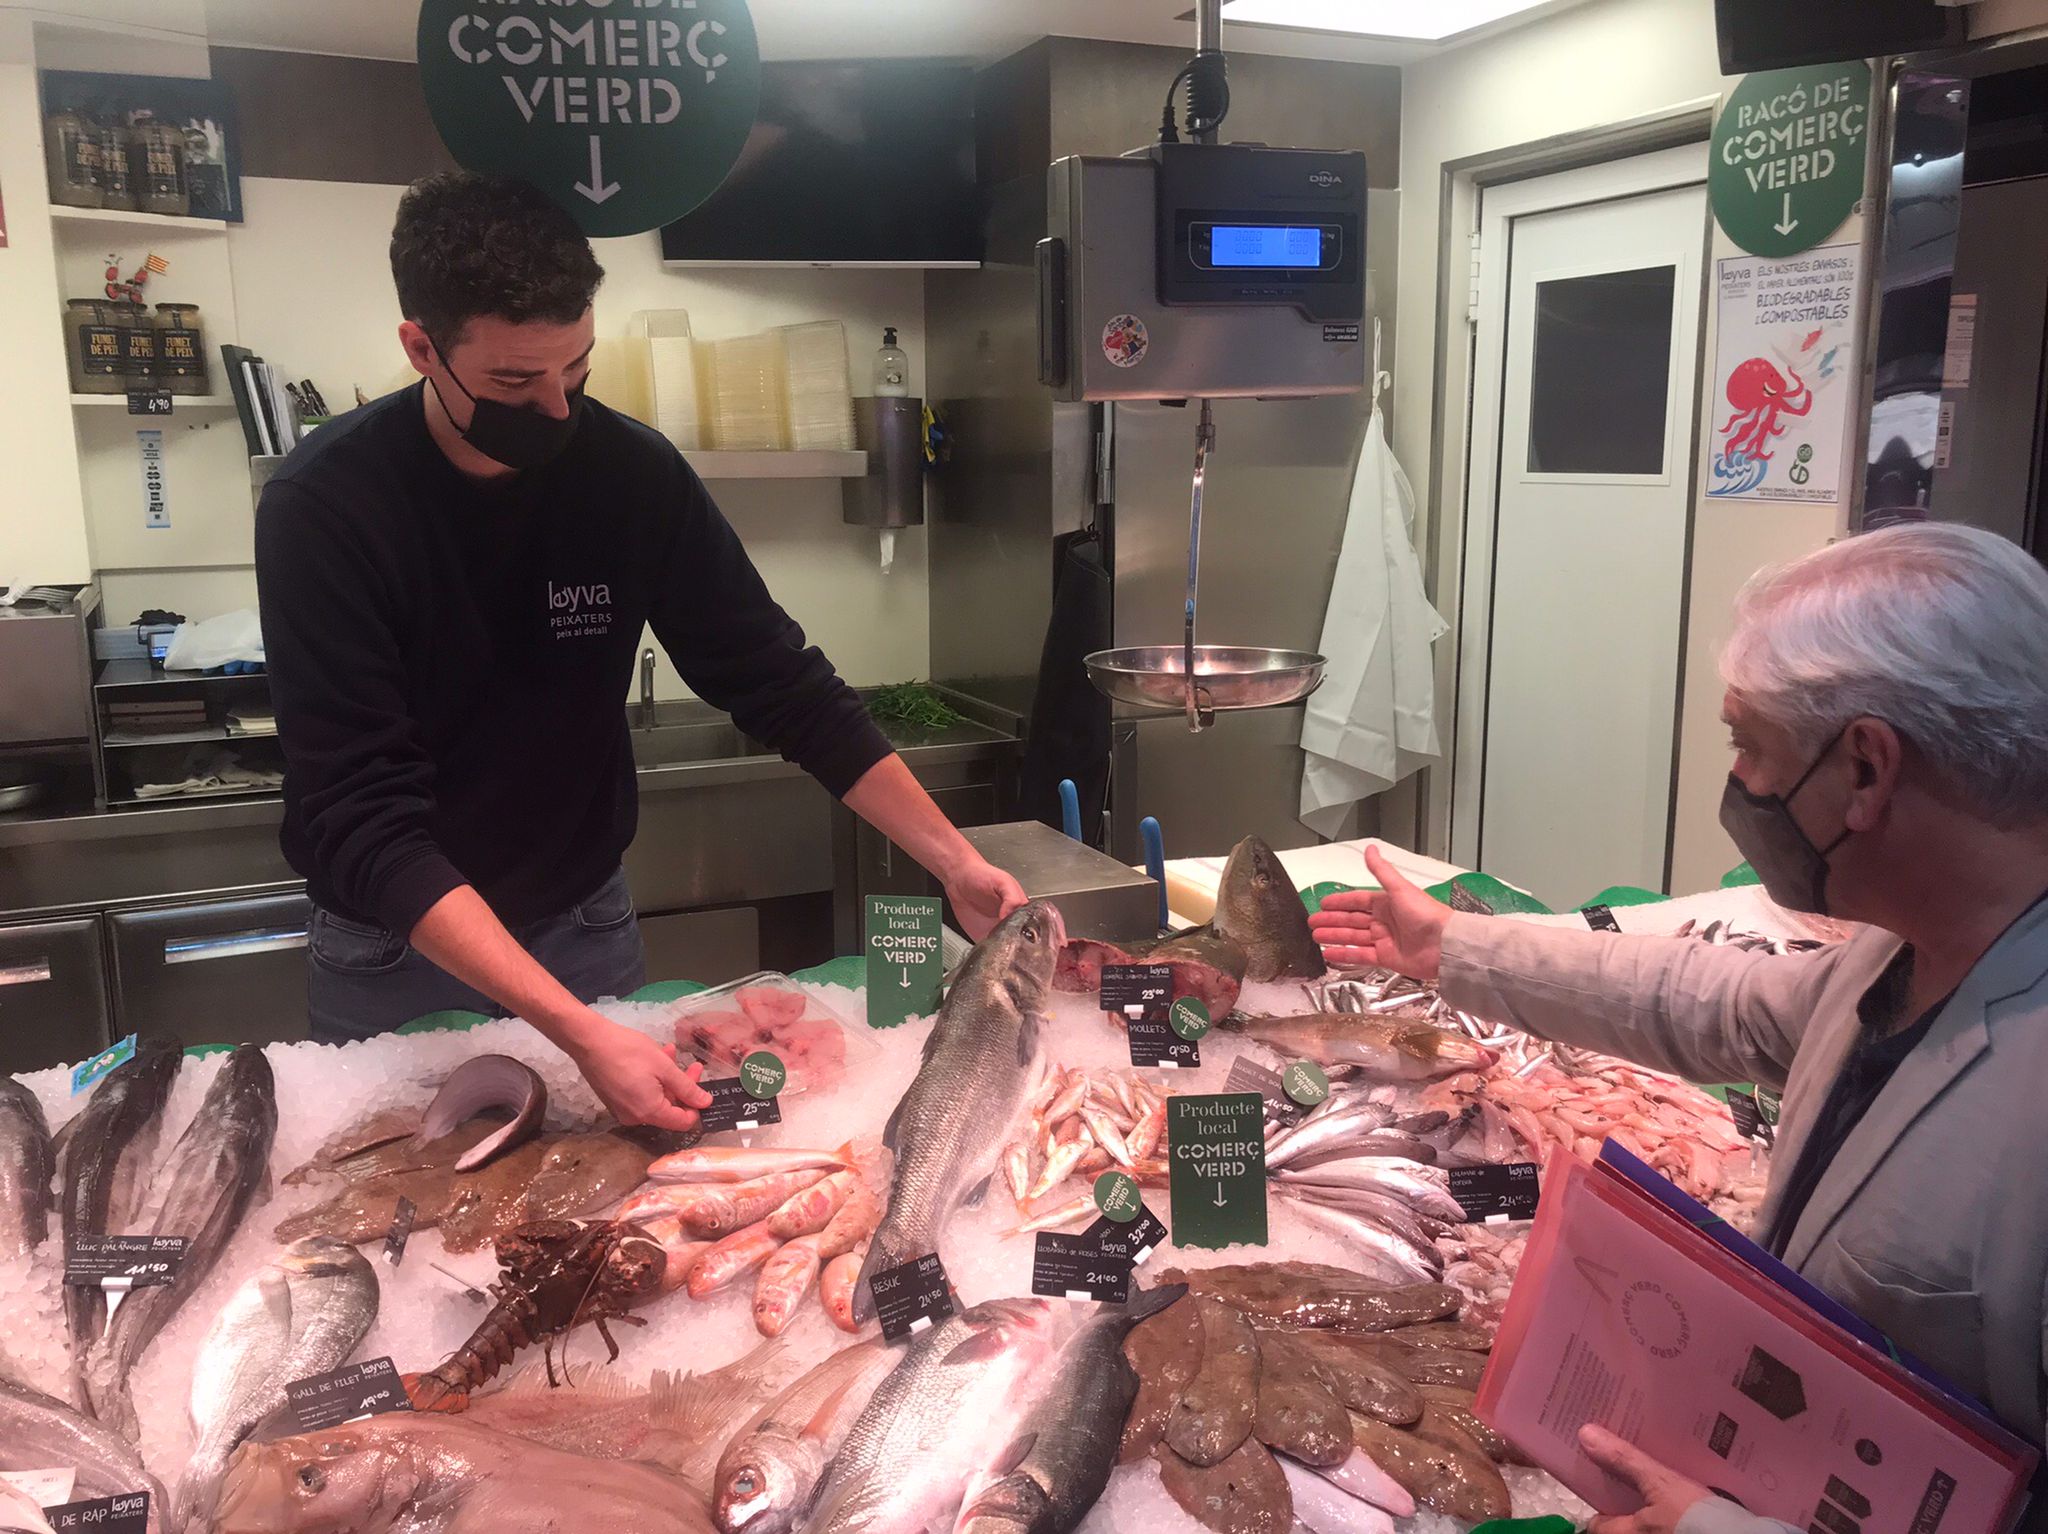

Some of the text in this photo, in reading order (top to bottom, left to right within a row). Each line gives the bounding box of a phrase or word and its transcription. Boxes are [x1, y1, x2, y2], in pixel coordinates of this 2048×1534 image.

[447, 14, 729, 84] COMERÇ
[501, 75, 682, 124] VERD
[1737, 76, 1850, 129] RACÓ DE
[1722, 104, 1865, 166] COMERÇ
[1309, 174, 1344, 184] DINA
[1744, 148, 1836, 193] VERD
[1720, 262, 1751, 283] leyva
[1757, 265, 1773, 277] ELS
[1774, 261, 1810, 275] NOSTRES
[1812, 257, 1848, 272] ENVASOS
[1756, 287, 1852, 308] BIODEGRADABLES
[1760, 304, 1850, 325] COMPOSTABLES
[548, 580, 612, 613] leyva
[550, 613, 613, 627] PEIXATERS
[556, 626, 608, 641] peix al detall
[873, 901, 935, 916] Producte
[888, 917, 921, 930] local
[871, 935, 938, 952] COMERÇ
[883, 950, 927, 964] VERD
[1175, 1003, 1208, 1029] COMERÇ
[1179, 1012, 1200, 1030] VERD
[1129, 1024, 1167, 1034] MOLLETS
[1191, 1051, 1200, 1061] €
[744, 1062, 783, 1081] COMERÇ
[750, 1071, 775, 1085] VERD
[1292, 1064, 1324, 1098] COMERÇ
[1293, 1075, 1314, 1097] VERD
[1178, 1100, 1256, 1118] Producte
[1197, 1119, 1239, 1136] local
[1176, 1141, 1260, 1161] COMERÇ
[1192, 1161, 1246, 1178] VERD
[1102, 1175, 1127, 1213] COMERÇ
[1112, 1187, 1130, 1211] VERD
[152, 1236, 183, 1249] leyva
[1100, 1239, 1128, 1255] leyva
[872, 1275, 901, 1295] BESUC
[292, 1360, 391, 1400] GALL DE FILET leyva
[61, 1513, 77, 1528] DE
[82, 1507, 108, 1524] RAP
[111, 1496, 144, 1513] leyva
